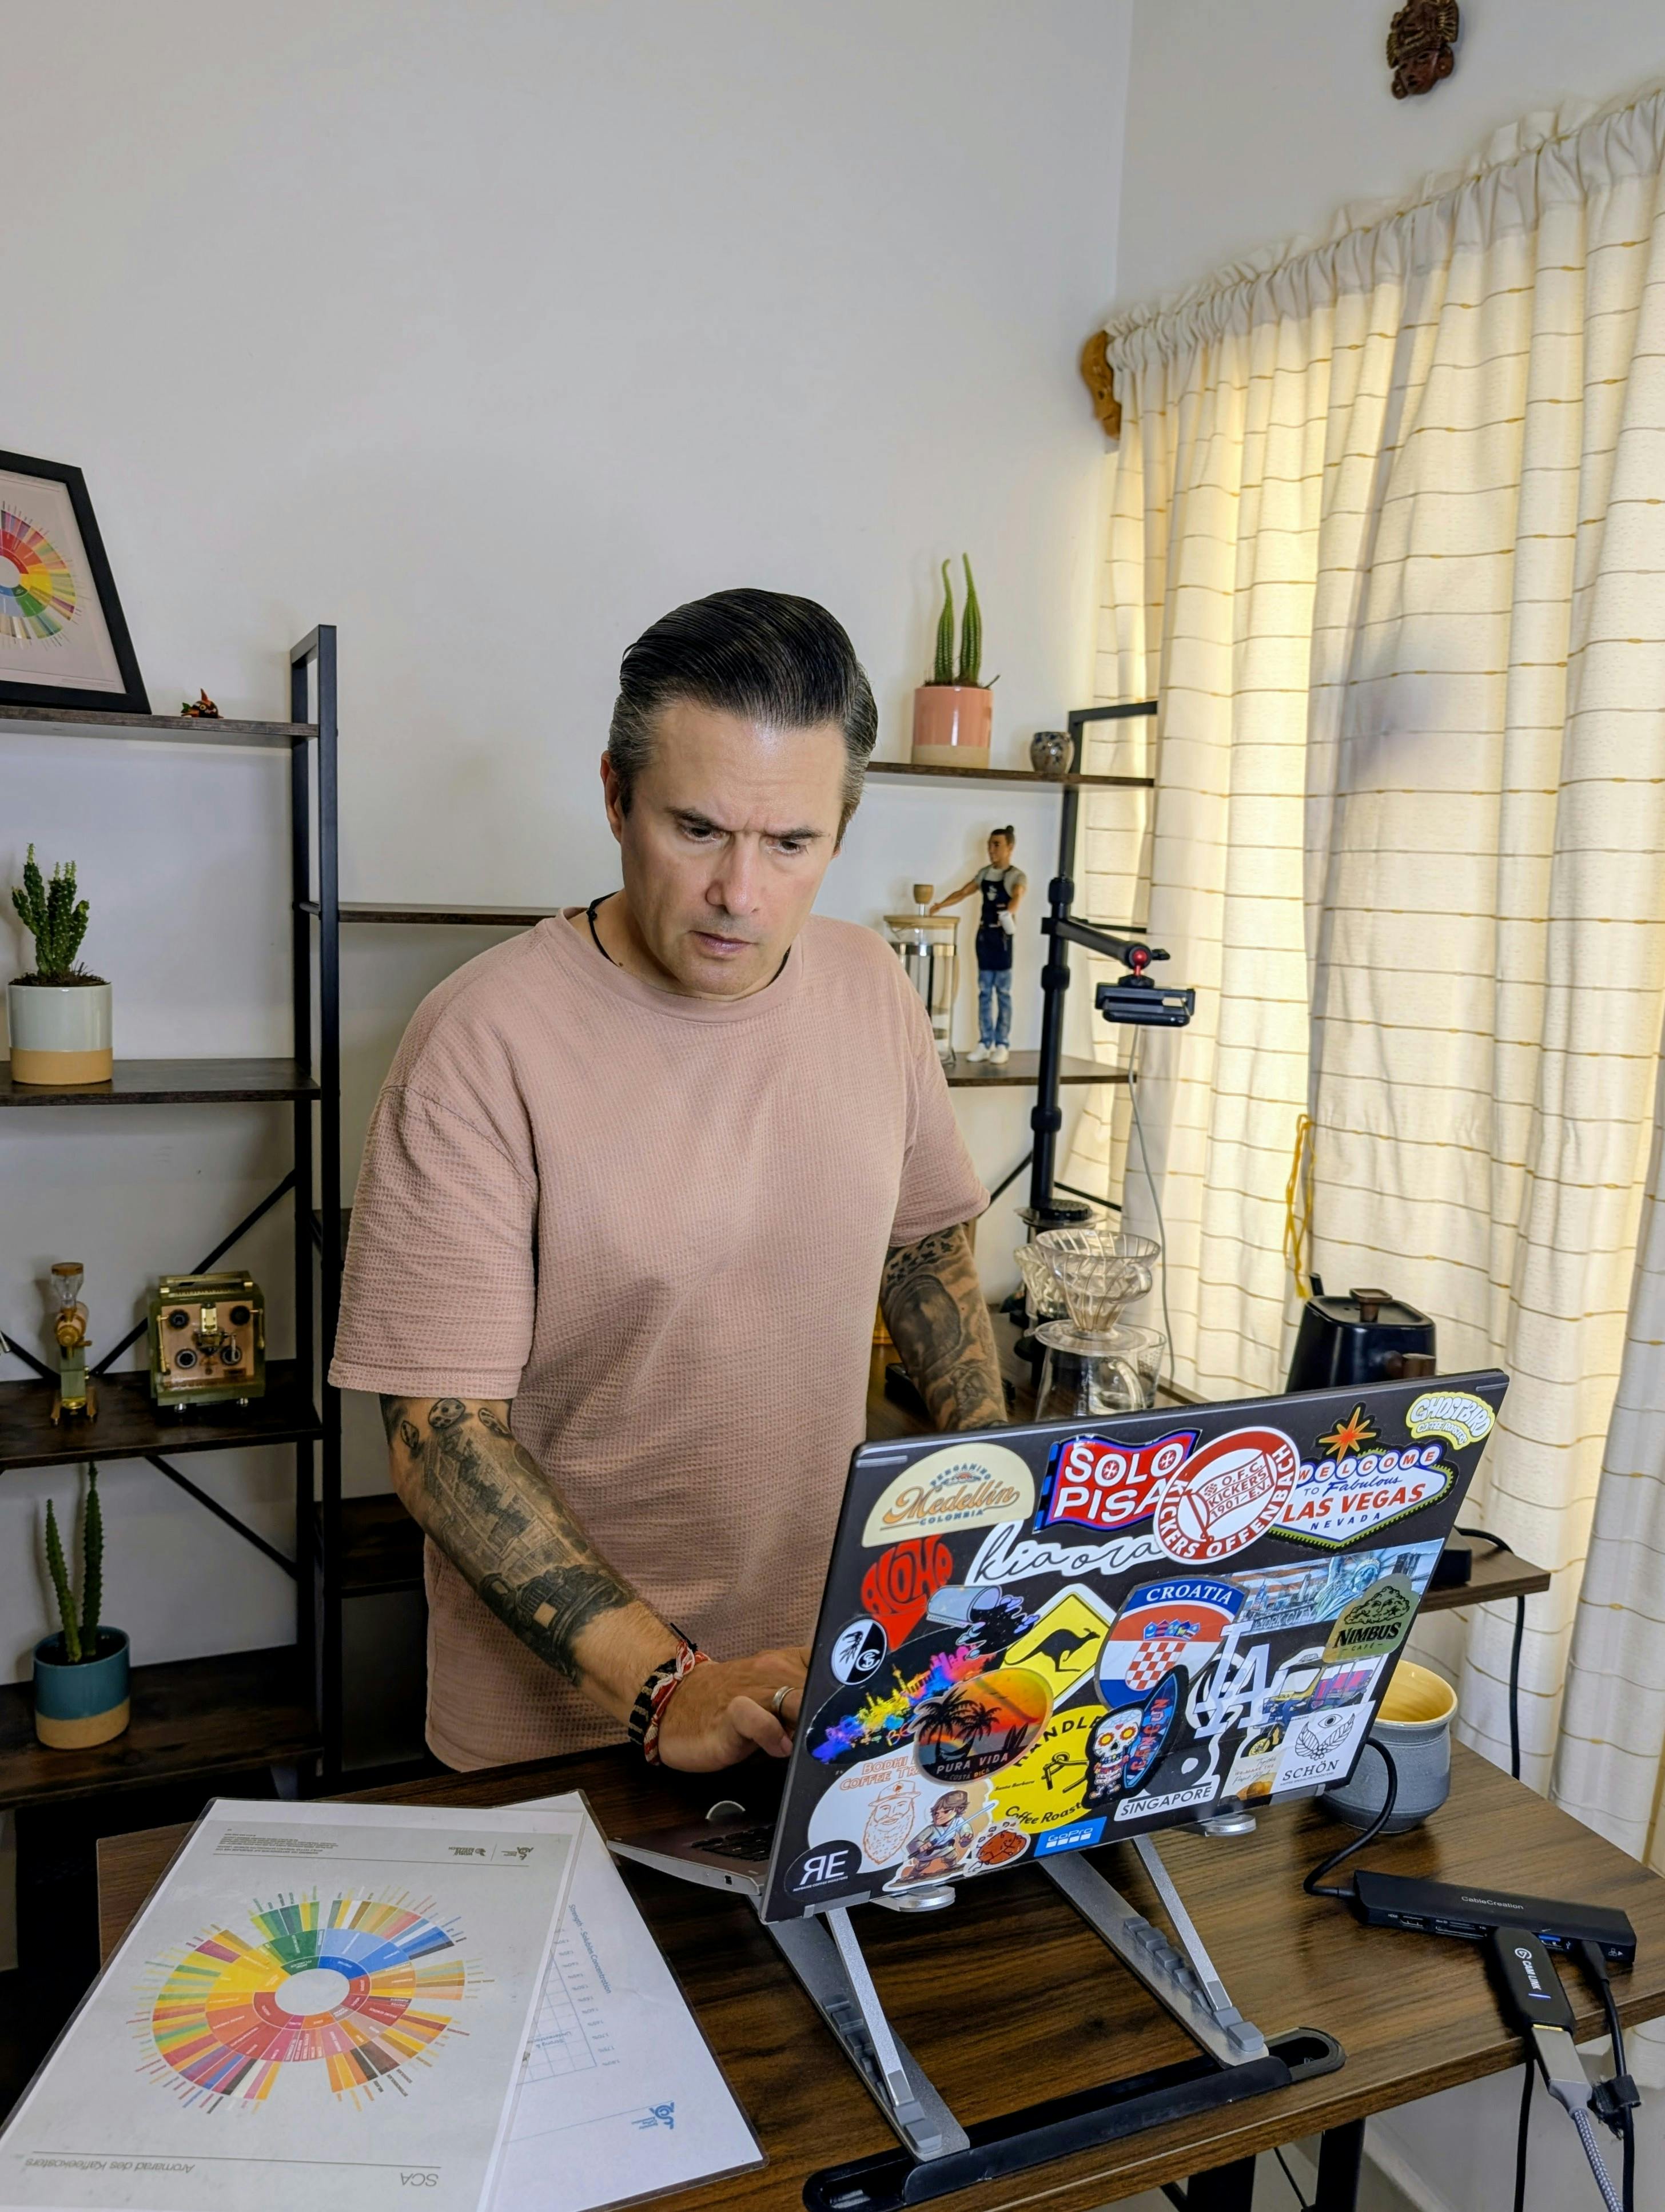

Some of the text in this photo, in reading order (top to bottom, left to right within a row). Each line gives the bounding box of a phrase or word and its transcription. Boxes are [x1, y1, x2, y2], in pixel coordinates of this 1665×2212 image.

[1411, 1397, 1491, 1437] GHOSTBIRD
[1065, 1443, 1184, 1487] SOLO
[1297, 1451, 1435, 1480] WELCOME
[1208, 1471, 1266, 1507] KICKERS
[1304, 1475, 1403, 1497] TO Fabulous
[1053, 1478, 1166, 1522] PISA
[1160, 1444, 1294, 1557] KICKERS OFFENBACH
[1282, 1483, 1425, 1522] LAS VEGAS
[919, 1510, 983, 1525] COLOMBIA
[1311, 1513, 1380, 1531] NEVADA
[1146, 1584, 1233, 1605] CROATIA
[1332, 1622, 1402, 1649] NIMBUS
[862, 1756, 909, 1775] BODHI
[936, 1753, 1009, 1775] PURA VIDA
[1282, 1760, 1340, 1781] SCHÖN
[840, 1771, 893, 1791] COFFEE
[1120, 1786, 1212, 1816] SINGAPORE
[1047, 1827, 1093, 1841] GoPro
[1461, 1896, 1524, 1910] CableCreation
[1522, 1960, 1542, 1990] CAM LINK
[400, 2173, 439, 2187] SCA
